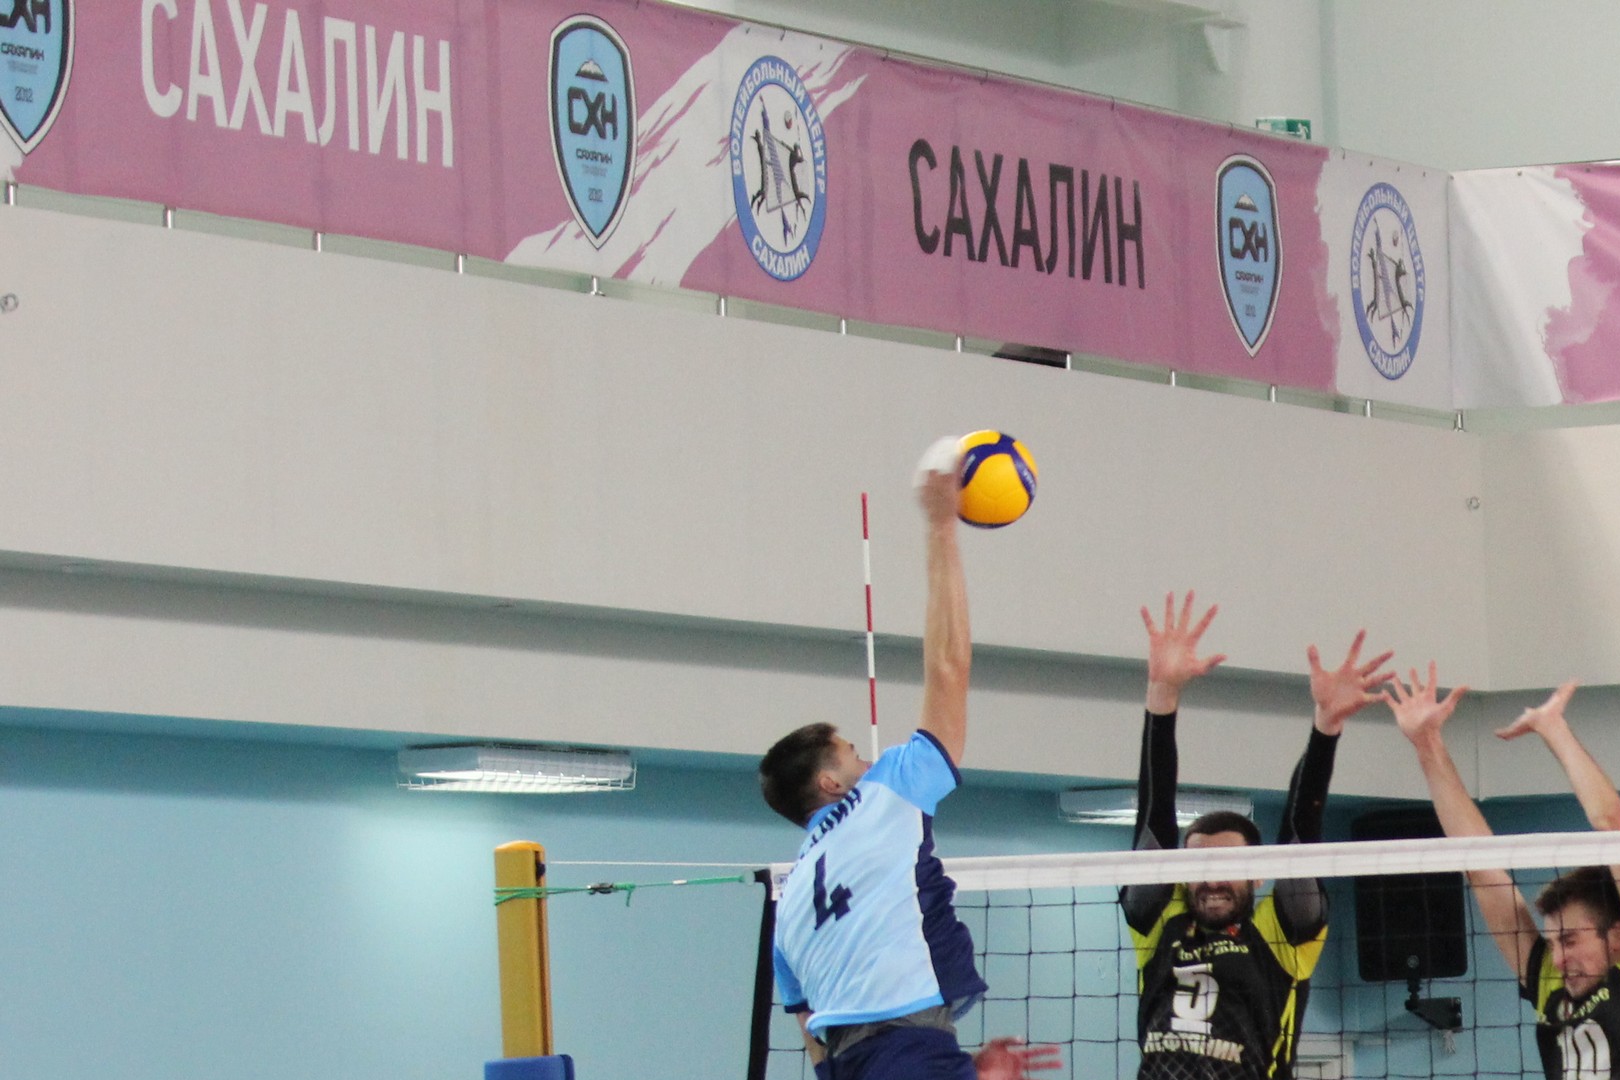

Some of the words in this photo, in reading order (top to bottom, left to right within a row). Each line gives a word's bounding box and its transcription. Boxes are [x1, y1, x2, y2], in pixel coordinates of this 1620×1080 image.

[140, 0, 454, 168] САХАЛИН
[567, 86, 619, 140] СХН
[732, 60, 805, 176] ВОЛЕЙБОЛЬНЫЙ
[805, 103, 826, 194] ЦЕНТР
[908, 138, 1145, 289] САХАЛИН
[1229, 217, 1268, 263] СХН
[752, 235, 811, 278] САХАЛИН
[813, 851, 853, 931] 4
[1172, 962, 1220, 1021] 5
